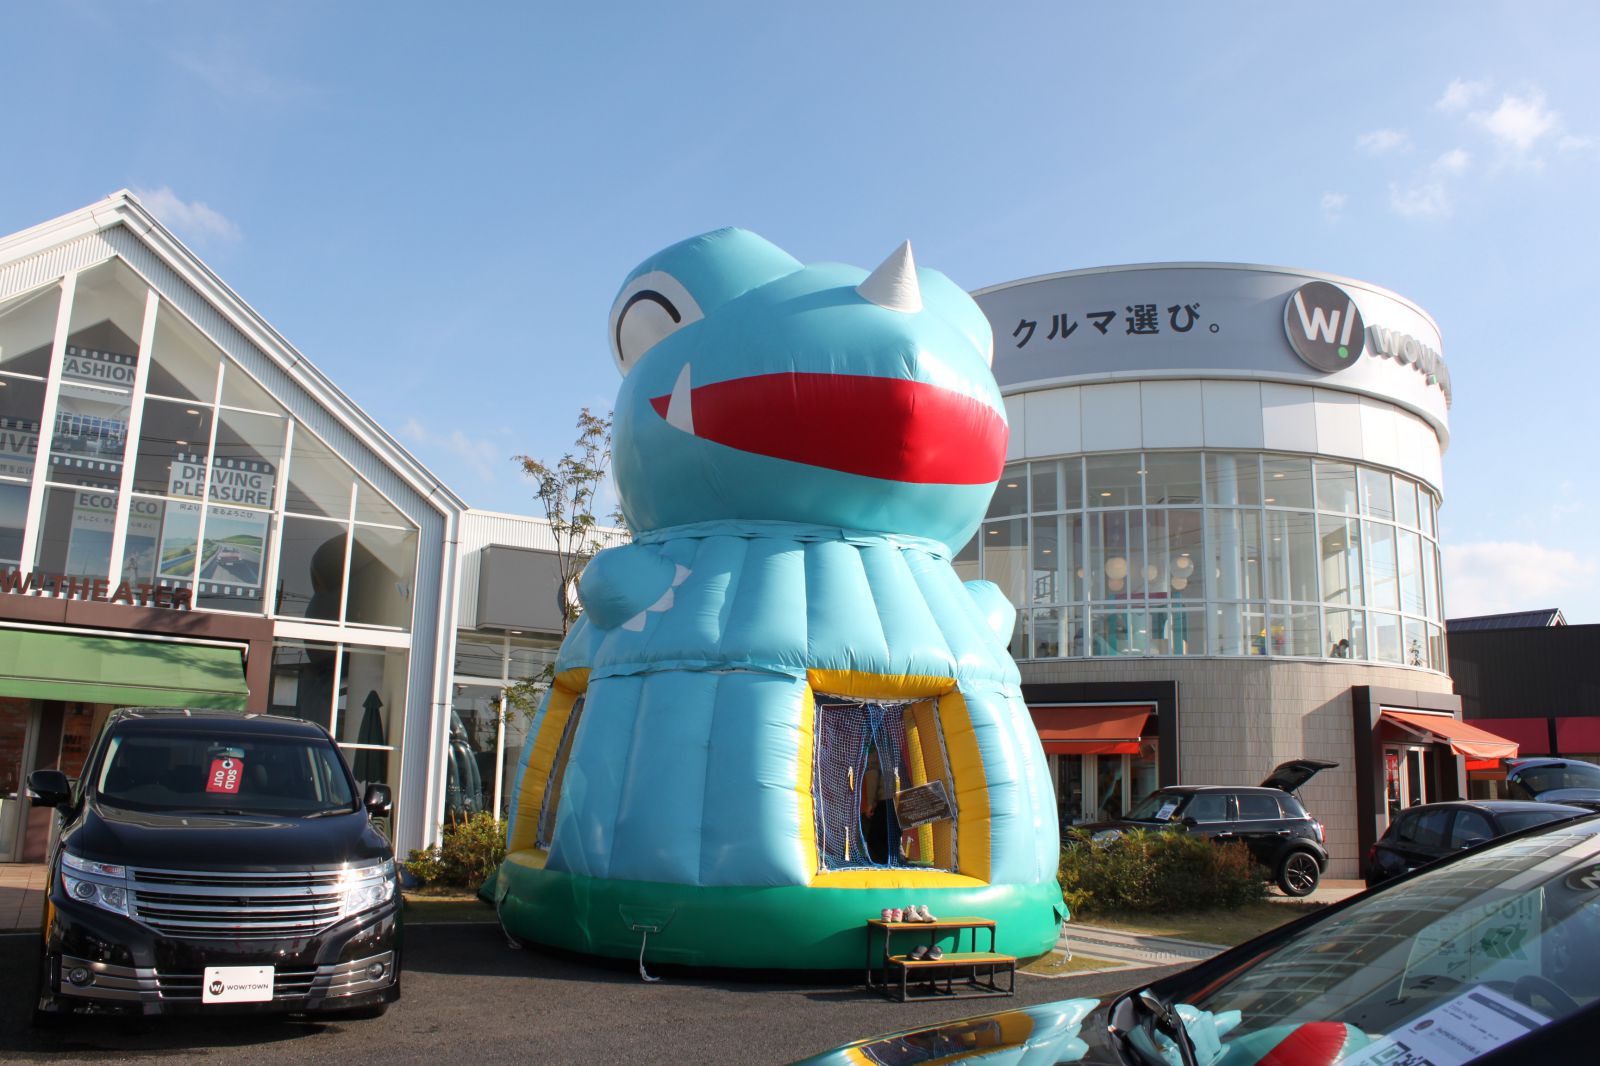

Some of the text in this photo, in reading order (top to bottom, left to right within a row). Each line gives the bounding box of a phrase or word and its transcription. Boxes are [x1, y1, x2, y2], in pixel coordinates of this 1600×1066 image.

[1012, 302, 1220, 349] クルマ選び。
[182, 465, 262, 489] DRIVING
[79, 493, 158, 514] ECOCO
[172, 480, 267, 506] PLEASURE
[213, 770, 225, 787] OUT
[225, 769, 237, 790] SOLD
